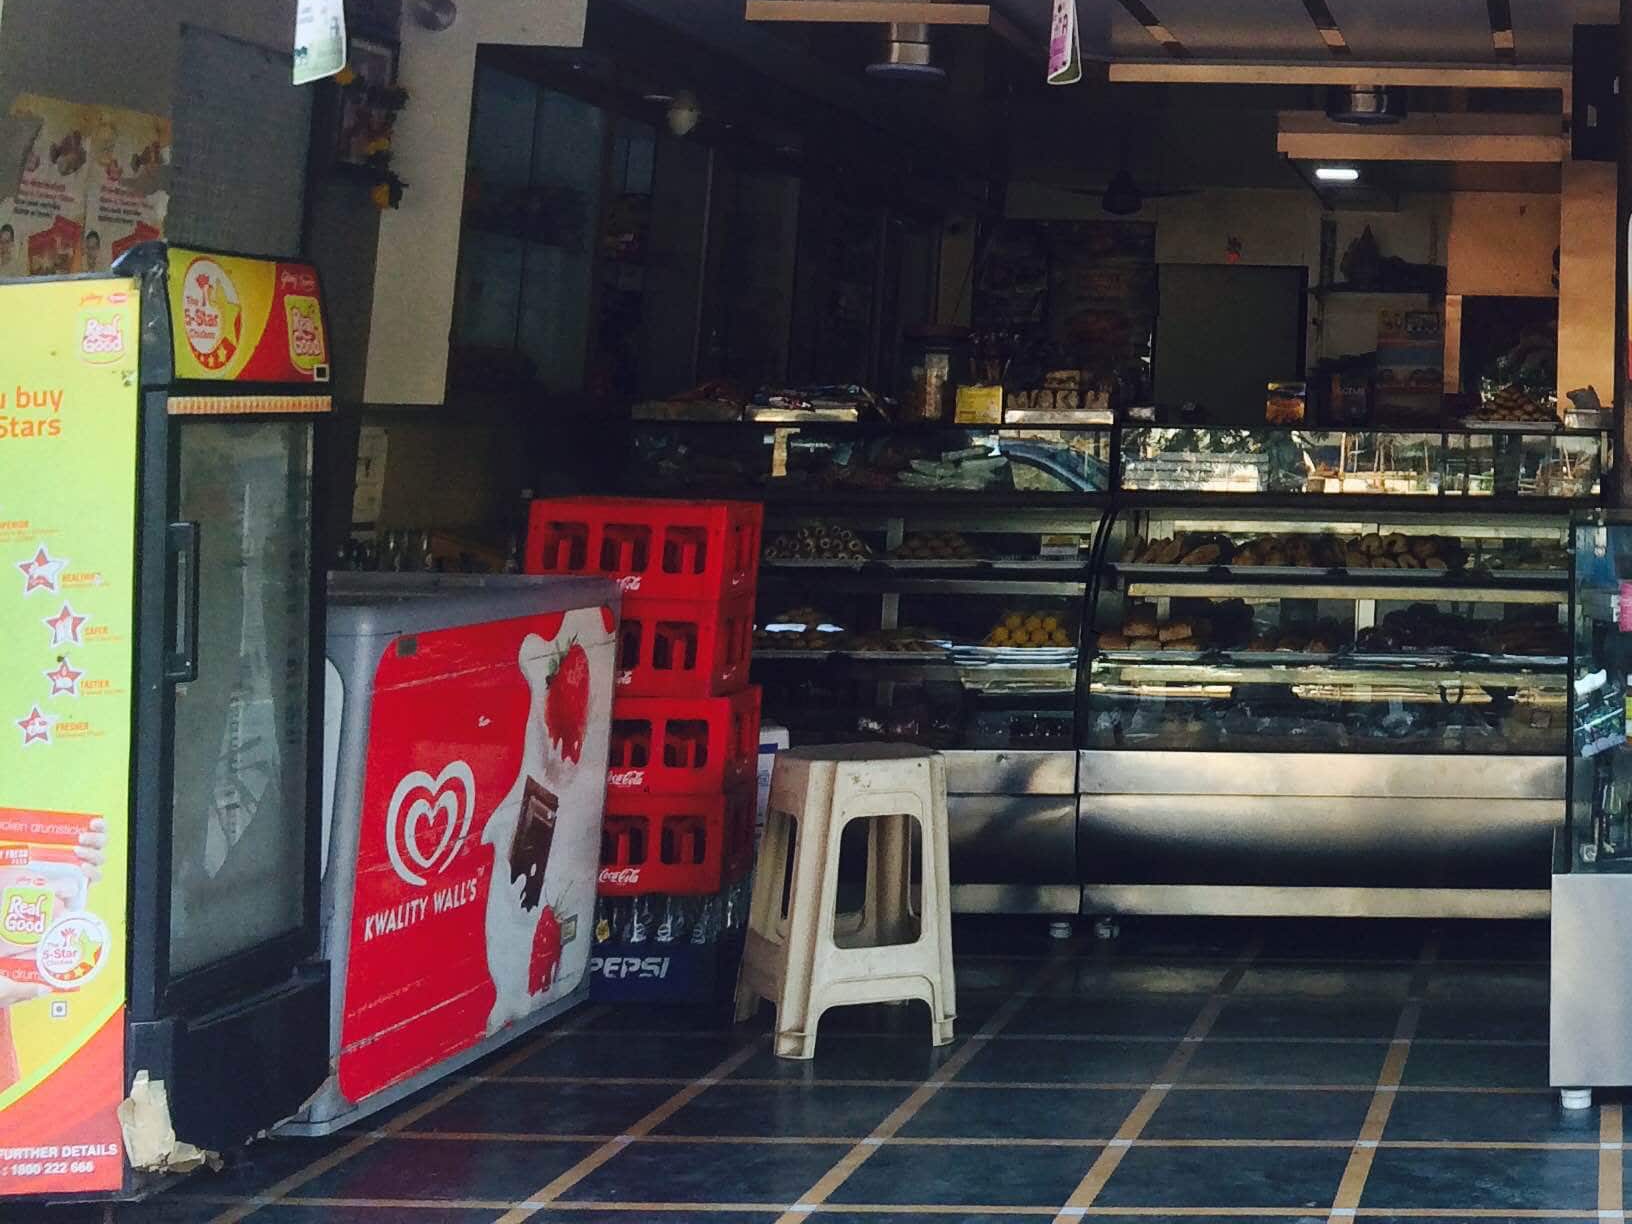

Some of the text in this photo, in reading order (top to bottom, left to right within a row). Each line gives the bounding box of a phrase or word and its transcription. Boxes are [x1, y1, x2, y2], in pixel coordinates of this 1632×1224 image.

[16, 385, 63, 413] buy
[10, 893, 48, 916] Real
[364, 877, 477, 942] KWALITY WALL'S
[5, 913, 45, 933] Good
[43, 947, 78, 960] 5-Star
[62, 1143, 118, 1157] DETAILS
[44, 1162, 67, 1174] 222
